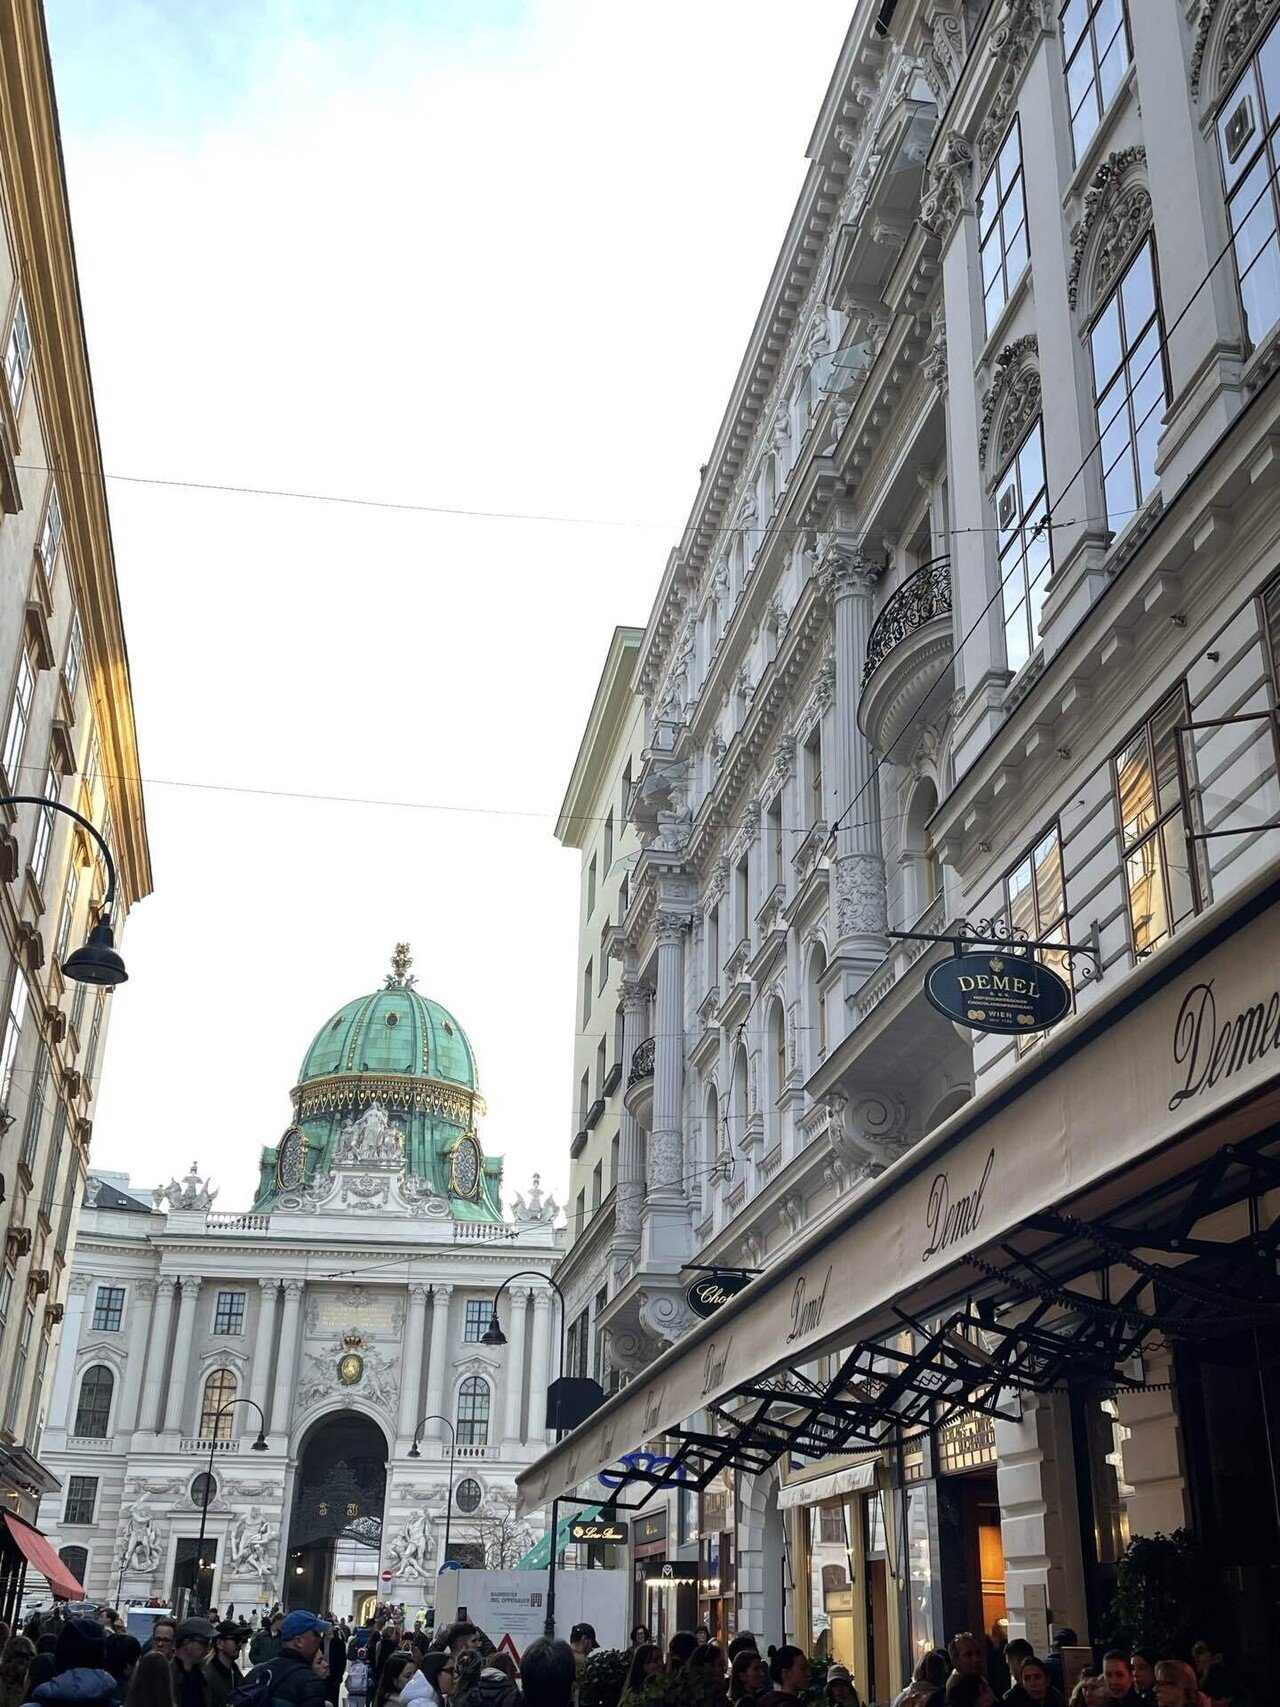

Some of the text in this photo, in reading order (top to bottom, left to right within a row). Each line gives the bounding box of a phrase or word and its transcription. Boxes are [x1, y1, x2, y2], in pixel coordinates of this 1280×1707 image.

[958, 975, 1041, 998] DEMEL
[988, 1010, 1012, 1018] WIEN
[922, 1148, 994, 1262] Demel
[787, 1265, 832, 1344] Demel
